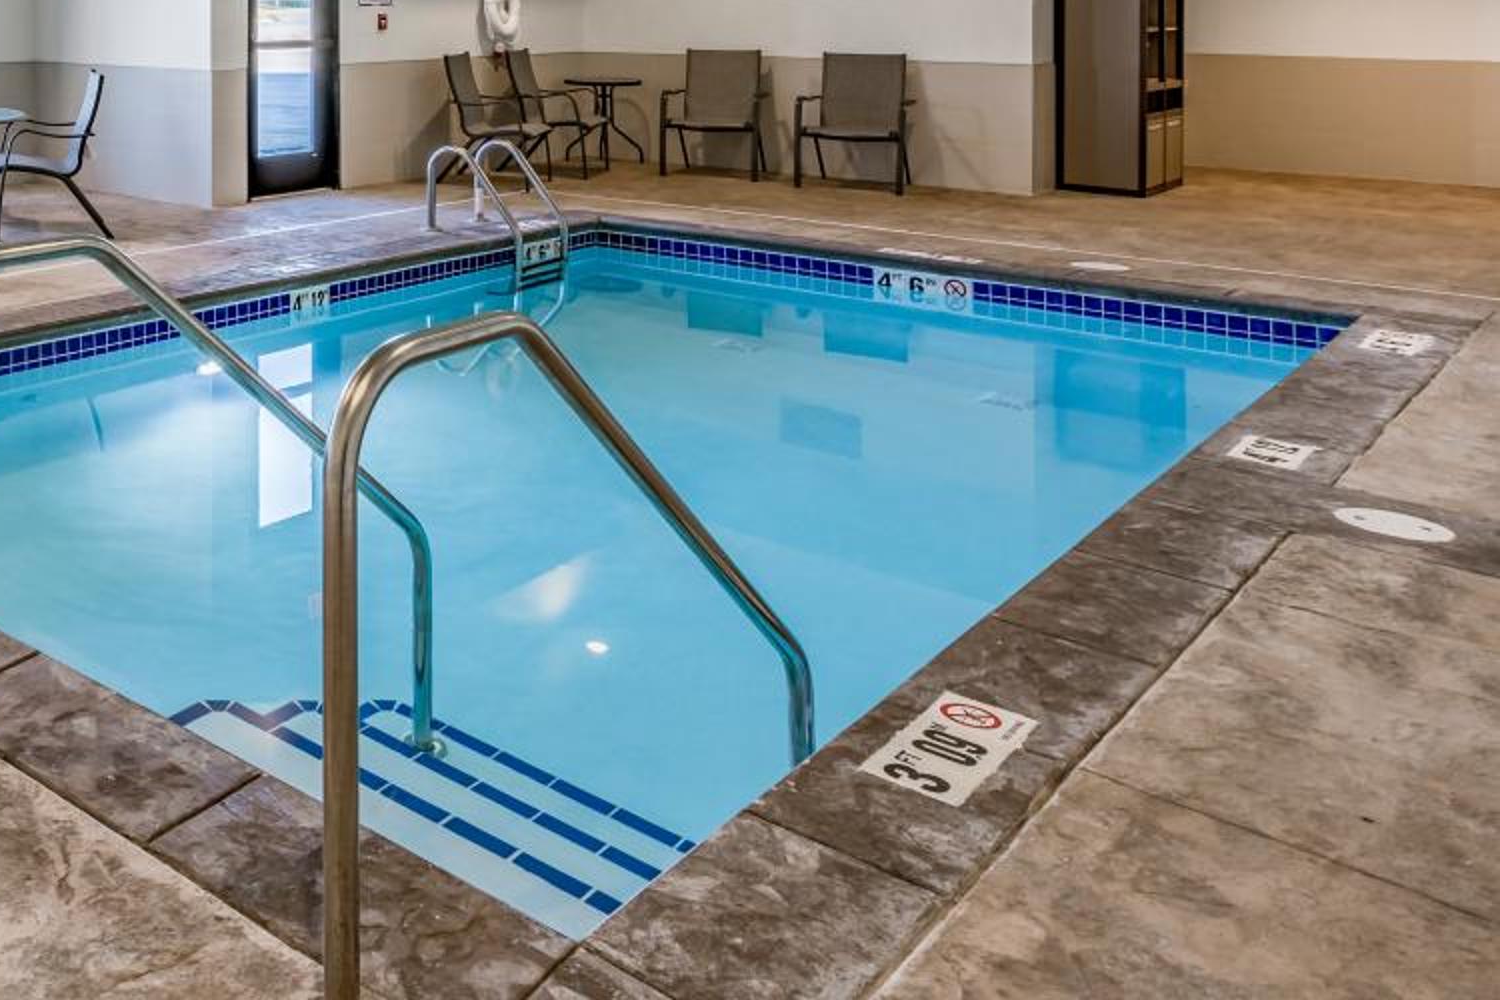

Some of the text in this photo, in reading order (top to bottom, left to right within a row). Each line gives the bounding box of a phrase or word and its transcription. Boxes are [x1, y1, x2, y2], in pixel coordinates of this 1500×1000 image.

[878, 272, 892, 287] 4
[909, 276, 925, 292] 6
[883, 763, 950, 793] 3
